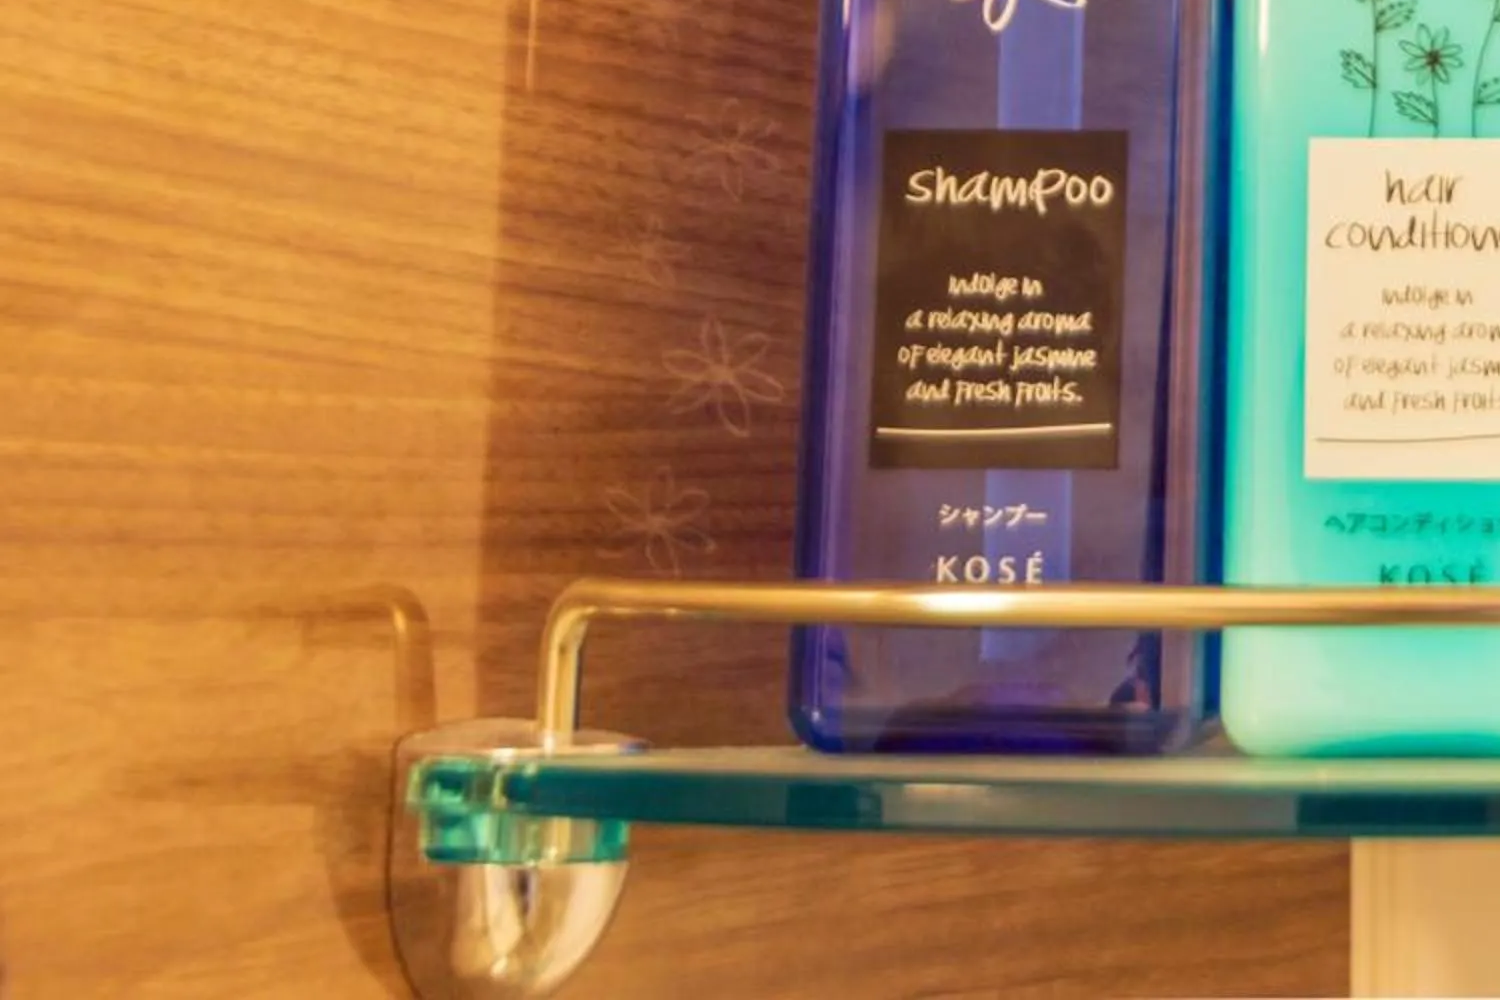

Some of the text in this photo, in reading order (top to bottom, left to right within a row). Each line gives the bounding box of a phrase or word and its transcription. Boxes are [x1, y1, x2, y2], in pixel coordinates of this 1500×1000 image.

[1384, 169, 1464, 206] hair
[1022, 276, 1043, 297] in
[905, 306, 1092, 336] a relaxing aroma
[1339, 320, 1355, 339] a
[926, 340, 1008, 370] elegant
[1009, 346, 1096, 372] jasmine
[906, 378, 950, 401] and
[1343, 390, 1385, 410] and
[938, 503, 1048, 528] シャンプー
[937, 550, 1044, 584] KOSÉ
